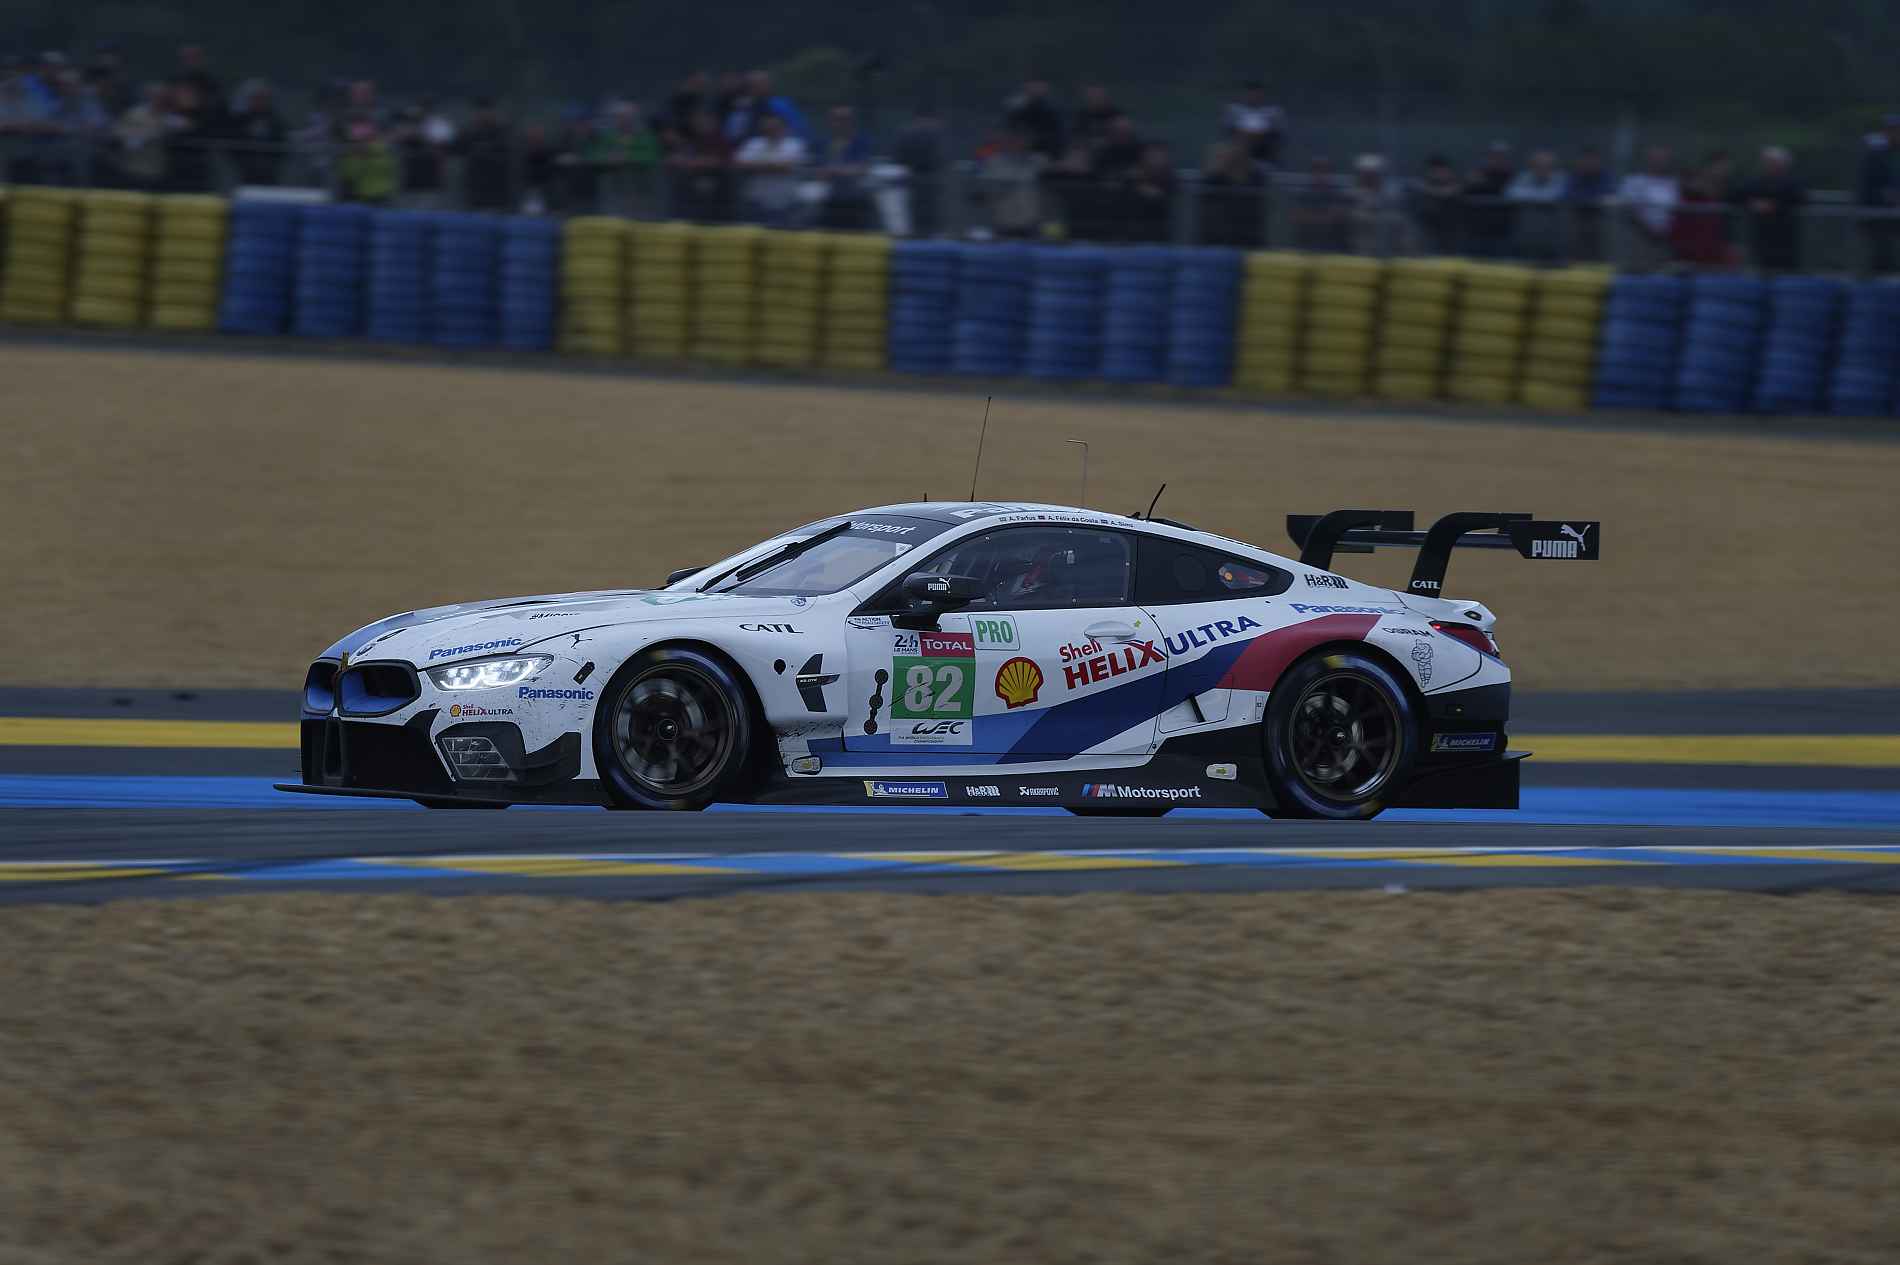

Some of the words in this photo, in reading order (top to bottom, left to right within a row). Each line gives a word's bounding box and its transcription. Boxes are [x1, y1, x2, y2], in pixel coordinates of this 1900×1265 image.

[1531, 540, 1578, 558] PUMA
[927, 583, 948, 591] PUMA
[1412, 580, 1441, 590] CATL
[1289, 603, 1405, 616] Panasonic
[739, 623, 804, 634] CATL
[975, 620, 1014, 644] PRO
[429, 637, 522, 660] Panasonic
[922, 639, 972, 650] TOTAL
[1059, 637, 1103, 663] Shell
[1062, 640, 1166, 690] HELIX
[1164, 615, 1263, 656] ULTRA
[518, 686, 595, 701] Panasonic
[904, 664, 964, 712] 82
[462, 706, 488, 717] HELIX
[488, 708, 513, 716] ULTRA
[911, 720, 965, 735] WEC
[888, 786, 940, 794] MICHELIN
[1117, 786, 1202, 800] Motorsport
